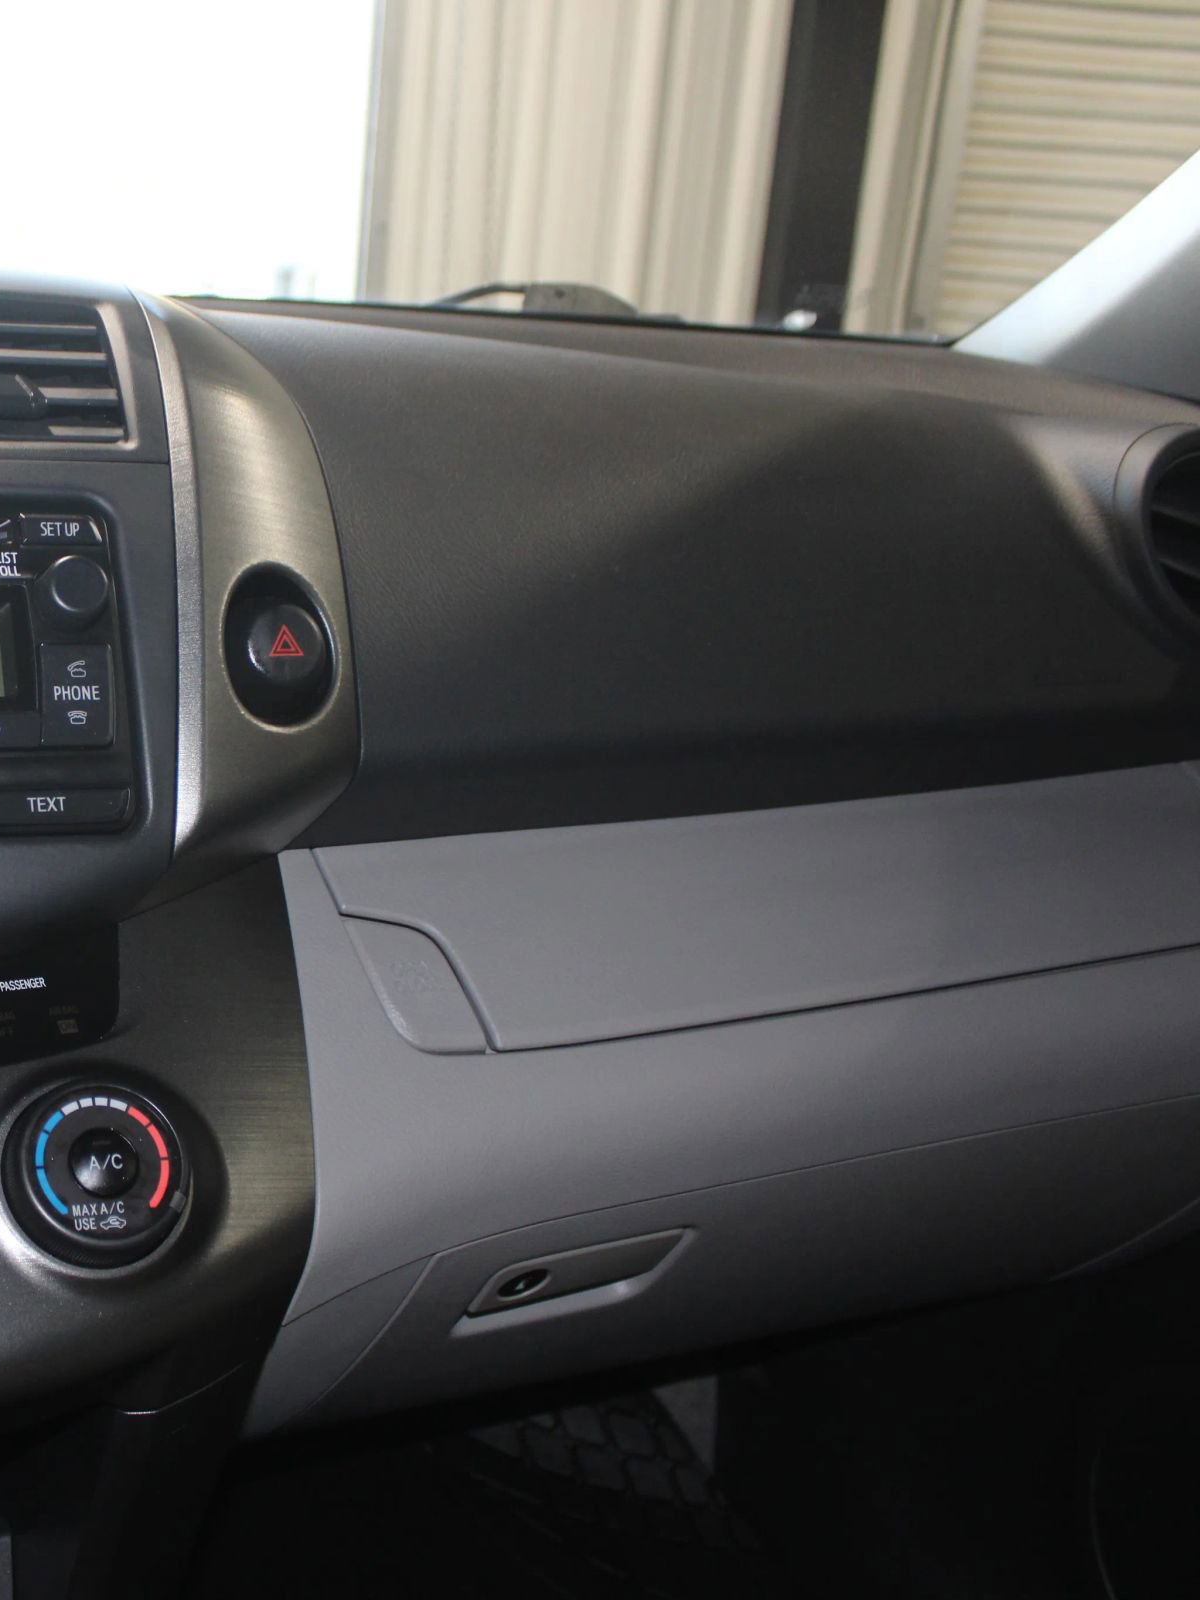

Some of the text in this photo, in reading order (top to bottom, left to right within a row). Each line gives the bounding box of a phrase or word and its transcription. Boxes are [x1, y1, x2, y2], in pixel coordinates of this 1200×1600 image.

[40, 521, 80, 537] SET UP
[53, 685, 101, 701] PHONE
[26, 796, 66, 813] TEXT
[0, 976, 46, 992] PASSENGER
[89, 1153, 123, 1170] A/C
[72, 1201, 125, 1217] MAX A/C
[74, 1218, 97, 1231] USE
